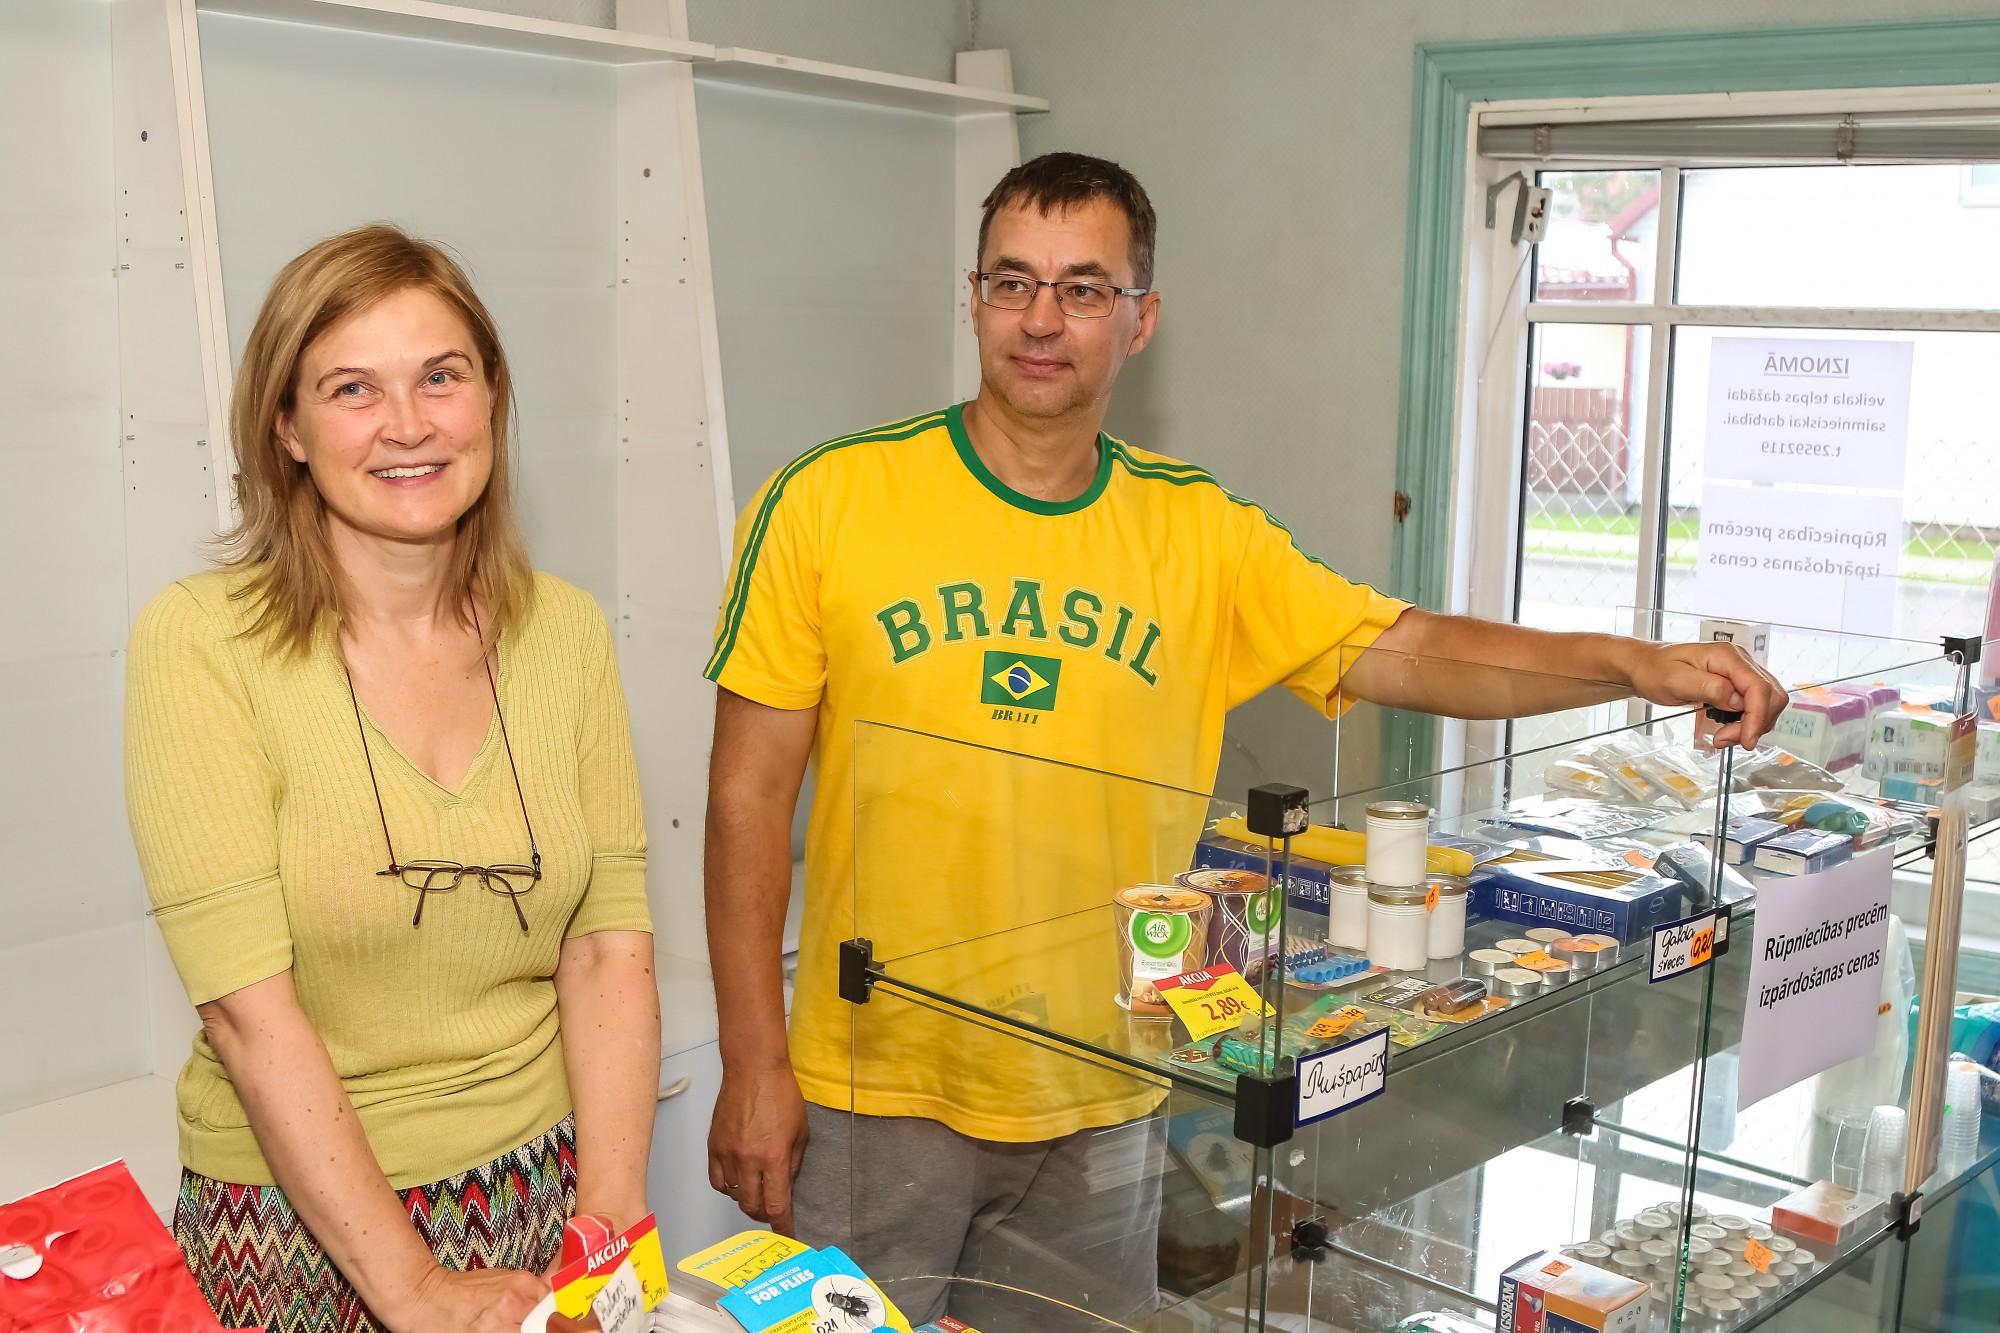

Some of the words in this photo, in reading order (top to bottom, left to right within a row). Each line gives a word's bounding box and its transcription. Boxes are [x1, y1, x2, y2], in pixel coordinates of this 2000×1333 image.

[873, 576, 1161, 690] BRASIL
[991, 709, 1014, 721] BR
[1146, 930, 1169, 939] WICK
[1764, 919, 1844, 962] Rūpniecības
[1845, 903, 1888, 940] precēm
[1178, 970, 1213, 986] AKCIJA
[1759, 961, 1845, 1010] izpārdošanas
[1846, 949, 1881, 976] cenas
[587, 1235, 630, 1274] AKCIJA
[751, 1286, 783, 1306] FOR
[778, 1269, 815, 1292] FLIES
